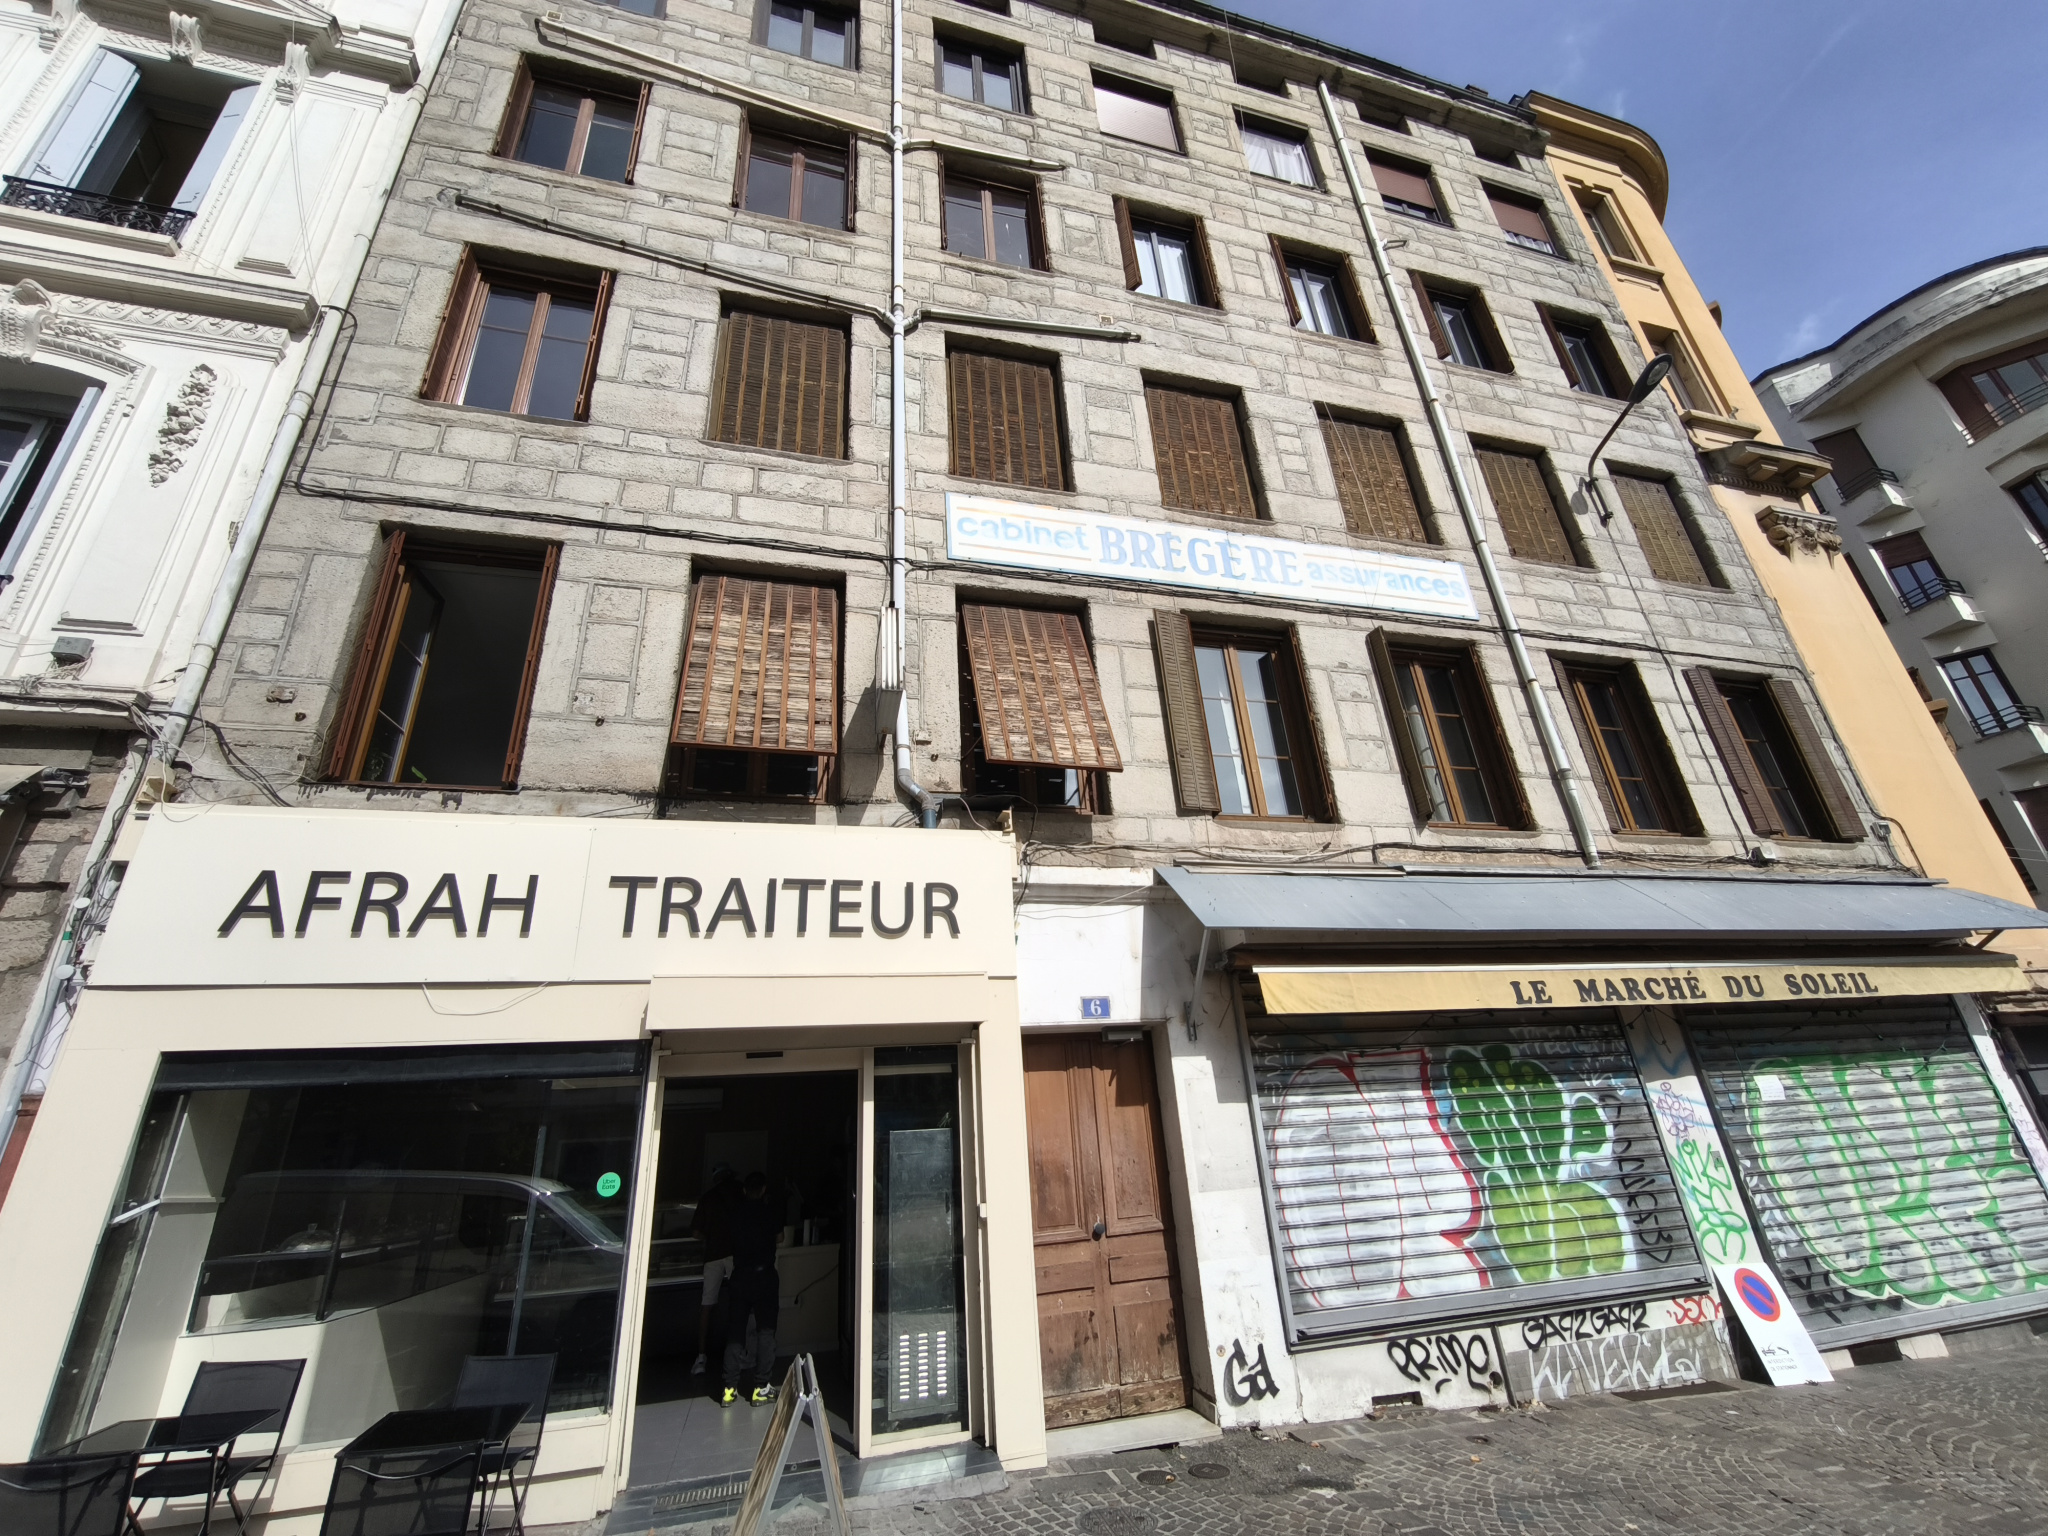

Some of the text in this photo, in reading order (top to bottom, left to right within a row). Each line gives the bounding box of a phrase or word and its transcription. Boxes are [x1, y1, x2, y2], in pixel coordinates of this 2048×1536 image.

[956, 516, 1090, 551] cabinet
[1306, 561, 1466, 599] assurances
[217, 870, 961, 939] AFRAH TRAITEUR
[1090, 998, 1102, 1016] 6
[1509, 970, 1879, 1005] LE MARCHÉ DU SOLEIL
